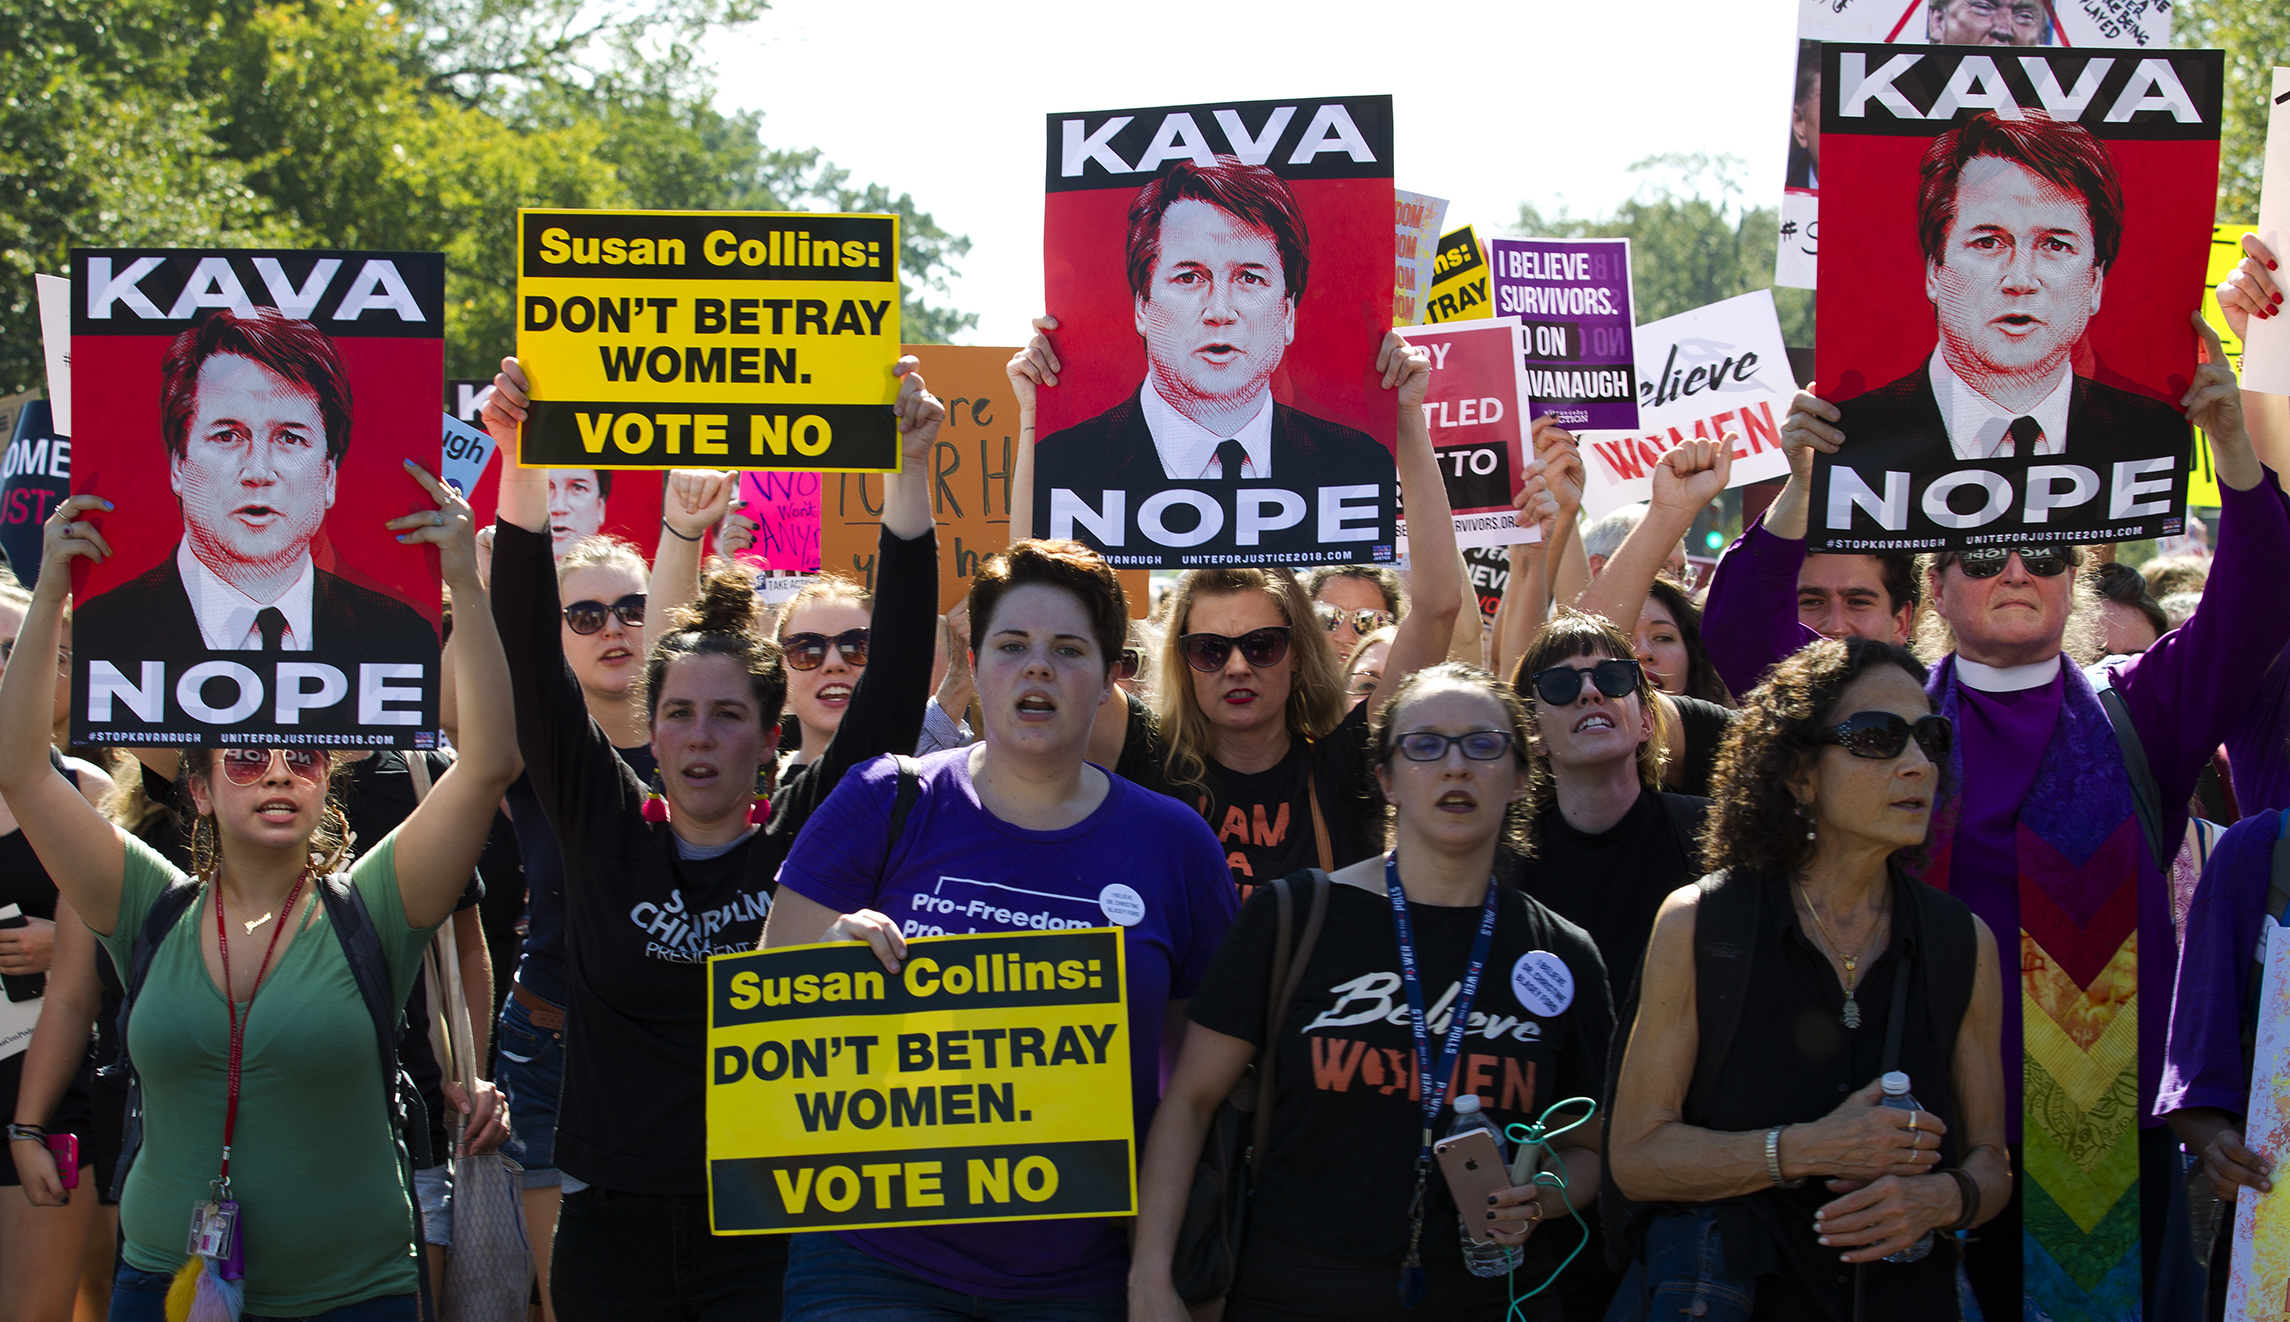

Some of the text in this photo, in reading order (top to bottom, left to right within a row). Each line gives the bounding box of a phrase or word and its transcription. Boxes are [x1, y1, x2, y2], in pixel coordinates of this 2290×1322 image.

[2117, 10, 2150, 46] BEING
[1839, 52, 2203, 123] KAVA
[1061, 103, 1377, 177] KAVA
[539, 227, 880, 268] Susan Collins:
[1433, 243, 1472, 276] ns:
[1499, 250, 1505, 277] I
[1509, 251, 1591, 280] BELIEVE
[87, 257, 427, 322] KAVA
[1500, 285, 1618, 315] SURVIVORS.
[524, 296, 891, 336] DON'T BETRAY
[1536, 326, 1567, 357] ON
[598, 346, 812, 384] WOMEN.
[940, 397, 993, 427] re
[575, 413, 832, 456] VOTE NO
[1449, 448, 1498, 477] TO
[1826, 456, 2175, 531] NOPE
[1049, 484, 1380, 547] NOPE
[1826, 538, 1946, 549] #STOPKAVANAUGH
[1966, 526, 2143, 545] UNITEFORJUSTICE2018.COM
[1182, 551, 1352, 564] UNITEFORJUSTICE2018.COM
[87, 660, 424, 725] NOPE
[88, 732, 201, 743] #STOPKAVANAUGH
[221, 733, 394, 745] UNITEFORJUSTICE2018.COM
[1219, 802, 1290, 847] AM
[903, 919, 982, 938] Pro-
[912, 893, 1092, 930] Pro-Freedom
[730, 953, 1102, 1010] Susan Collins:
[713, 1023, 1118, 1086] DON'T BETRAY
[795, 1082, 1032, 1133] WOMEN.
[773, 1155, 1059, 1214] VOTE NO
